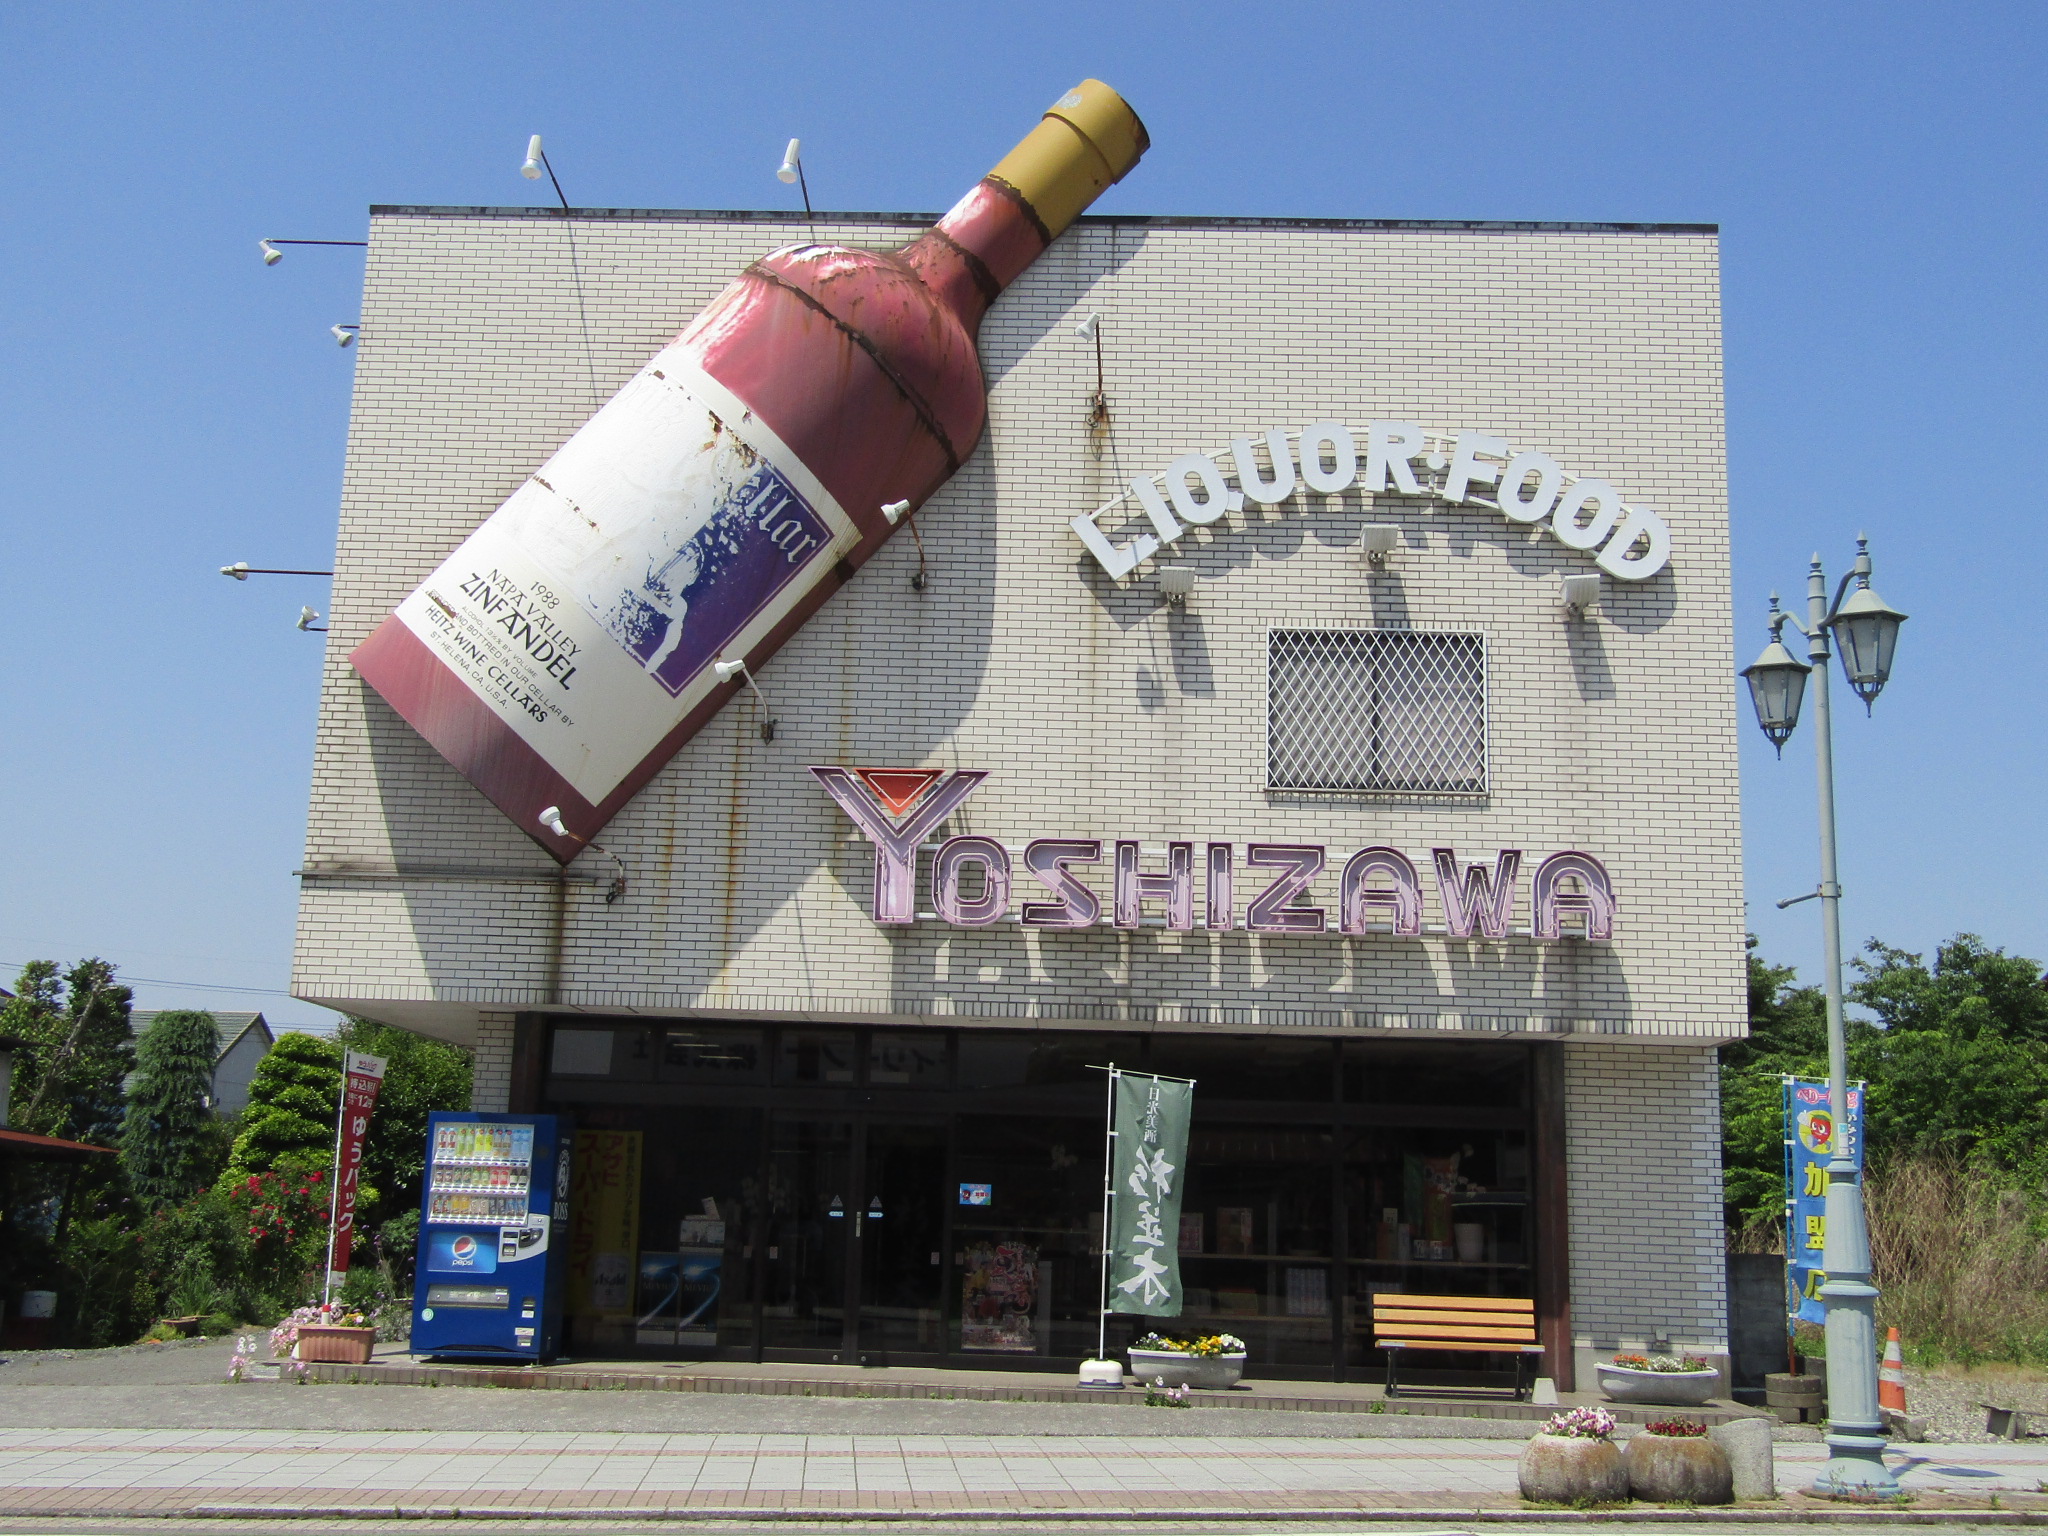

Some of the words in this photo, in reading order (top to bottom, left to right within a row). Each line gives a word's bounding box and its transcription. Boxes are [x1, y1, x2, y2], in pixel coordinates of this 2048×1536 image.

[459, 572, 577, 691] ZINFANDEL
[487, 568, 528, 607] NAPA
[526, 602, 582, 658] VALLEY
[530, 581, 560, 610] 1988
[425, 604, 456, 635] HEITZ
[453, 631, 489, 667] WINE
[487, 665, 548, 723] CELLARS
[430, 630, 443, 643] ST.
[485, 684, 508, 710] U.S.A.
[462, 606, 485, 628] ALCOHOL
[501, 643, 513, 654] BY
[512, 653, 538, 679] VOLUME
[500, 655, 511, 667] IN
[511, 666, 530, 685] OUR
[528, 683, 562, 717] CELLAR
[560, 714, 575, 727] BY
[808, 765, 1616, 941] YOSHIZAWA
[452, 1259, 474, 1267] pepsi
